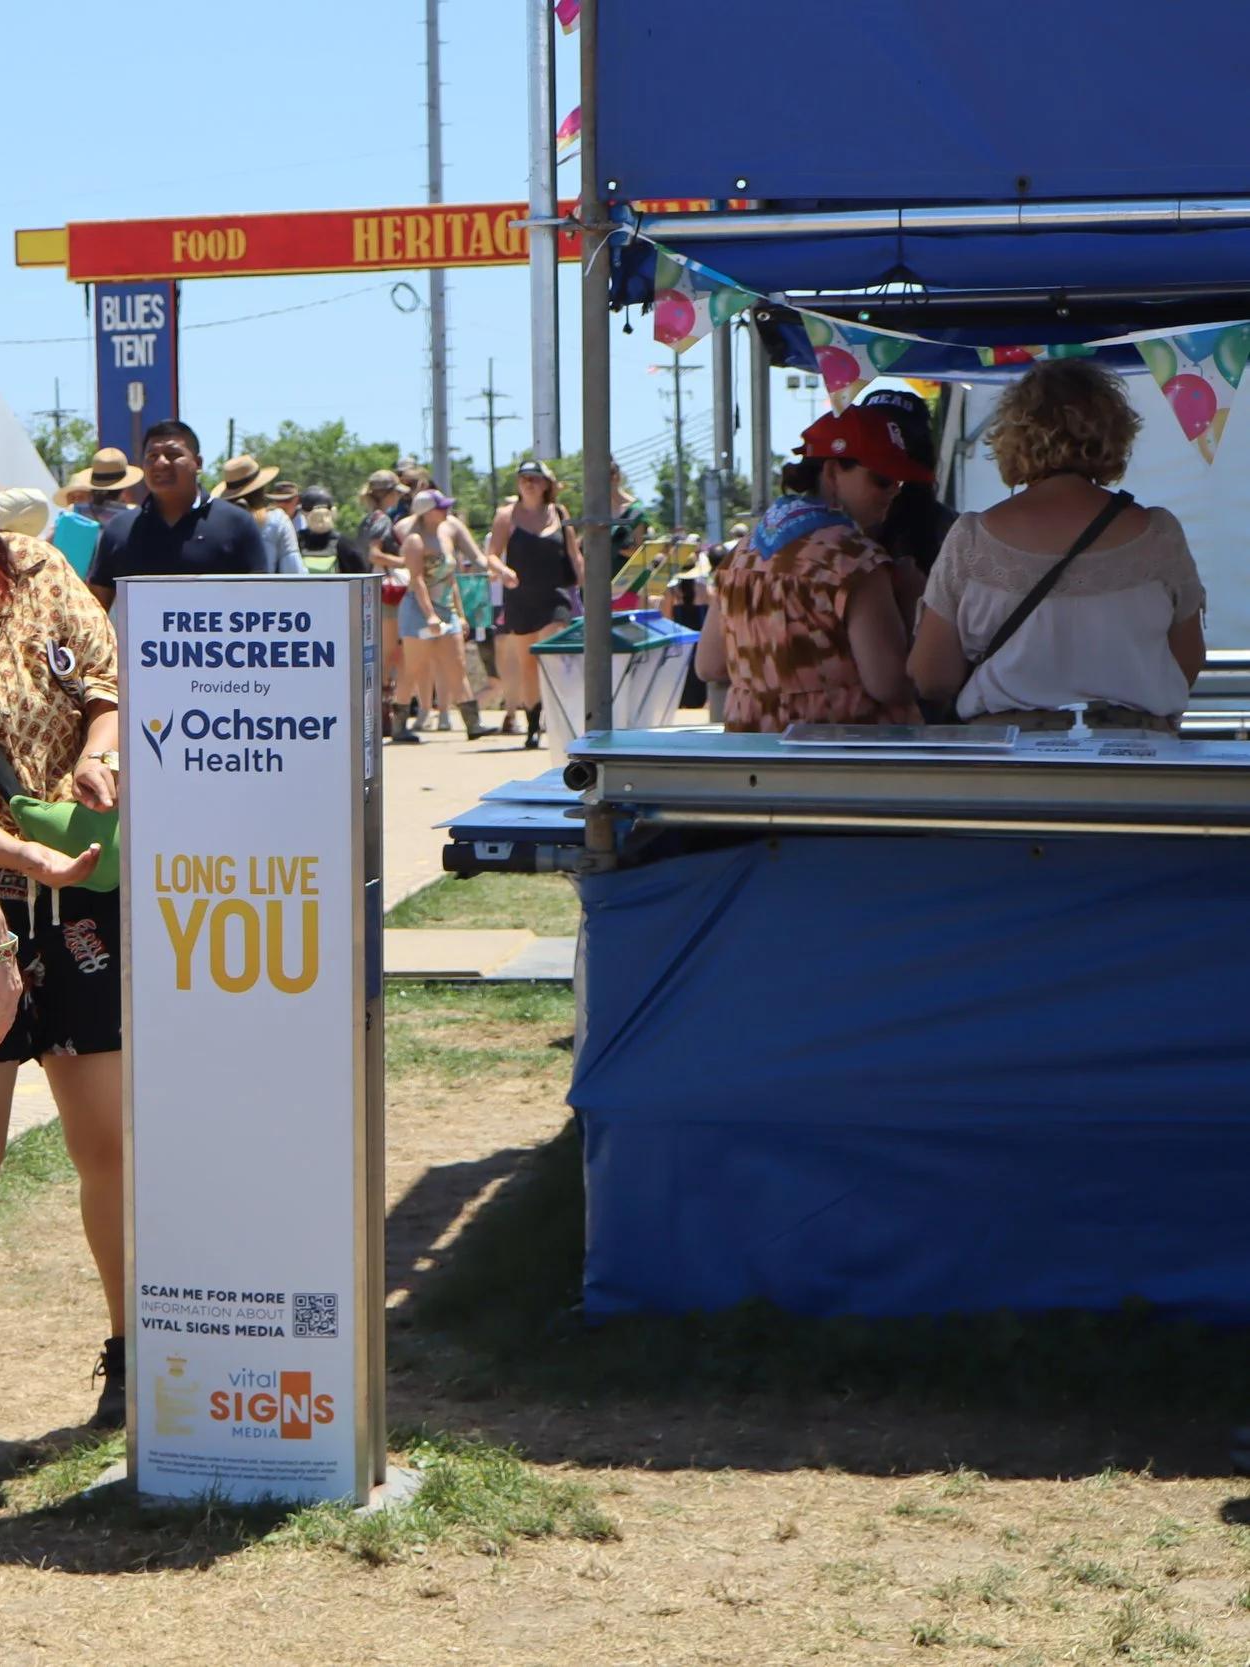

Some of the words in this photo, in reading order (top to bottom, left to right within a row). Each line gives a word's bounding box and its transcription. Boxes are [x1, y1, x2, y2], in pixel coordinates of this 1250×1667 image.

[172, 228, 247, 263] FOOD
[101, 294, 165, 331] BLUES
[111, 334, 157, 368] TENT
[162, 611, 223, 632] FREE
[229, 611, 312, 633] SPF50
[140, 640, 335, 668] SUNSCREEN
[190, 680, 250, 694] Provided
[254, 680, 271, 697] by
[181, 708, 337, 740] Ochsner
[184, 747, 283, 772] Health
[155, 853, 236, 895] LONG
[249, 856, 319, 896] LIVE
[157, 897, 319, 995] YOU
[141, 1284, 179, 1298] SCAN
[183, 1288, 203, 1300] ME
[207, 1290, 237, 1302] FOR
[241, 1292, 285, 1304] MORE
[141, 1300, 231, 1318] INFORMATION
[236, 1308, 285, 1320] ABOUT
[142, 1317, 182, 1332] VITAL
[186, 1322, 230, 1335] SIGNS
[235, 1324, 285, 1337] MEDIA
[228, 1367, 277, 1389] vital
[210, 1390, 335, 1424] SIGNS
[231, 1426, 279, 1439] MEDIA
